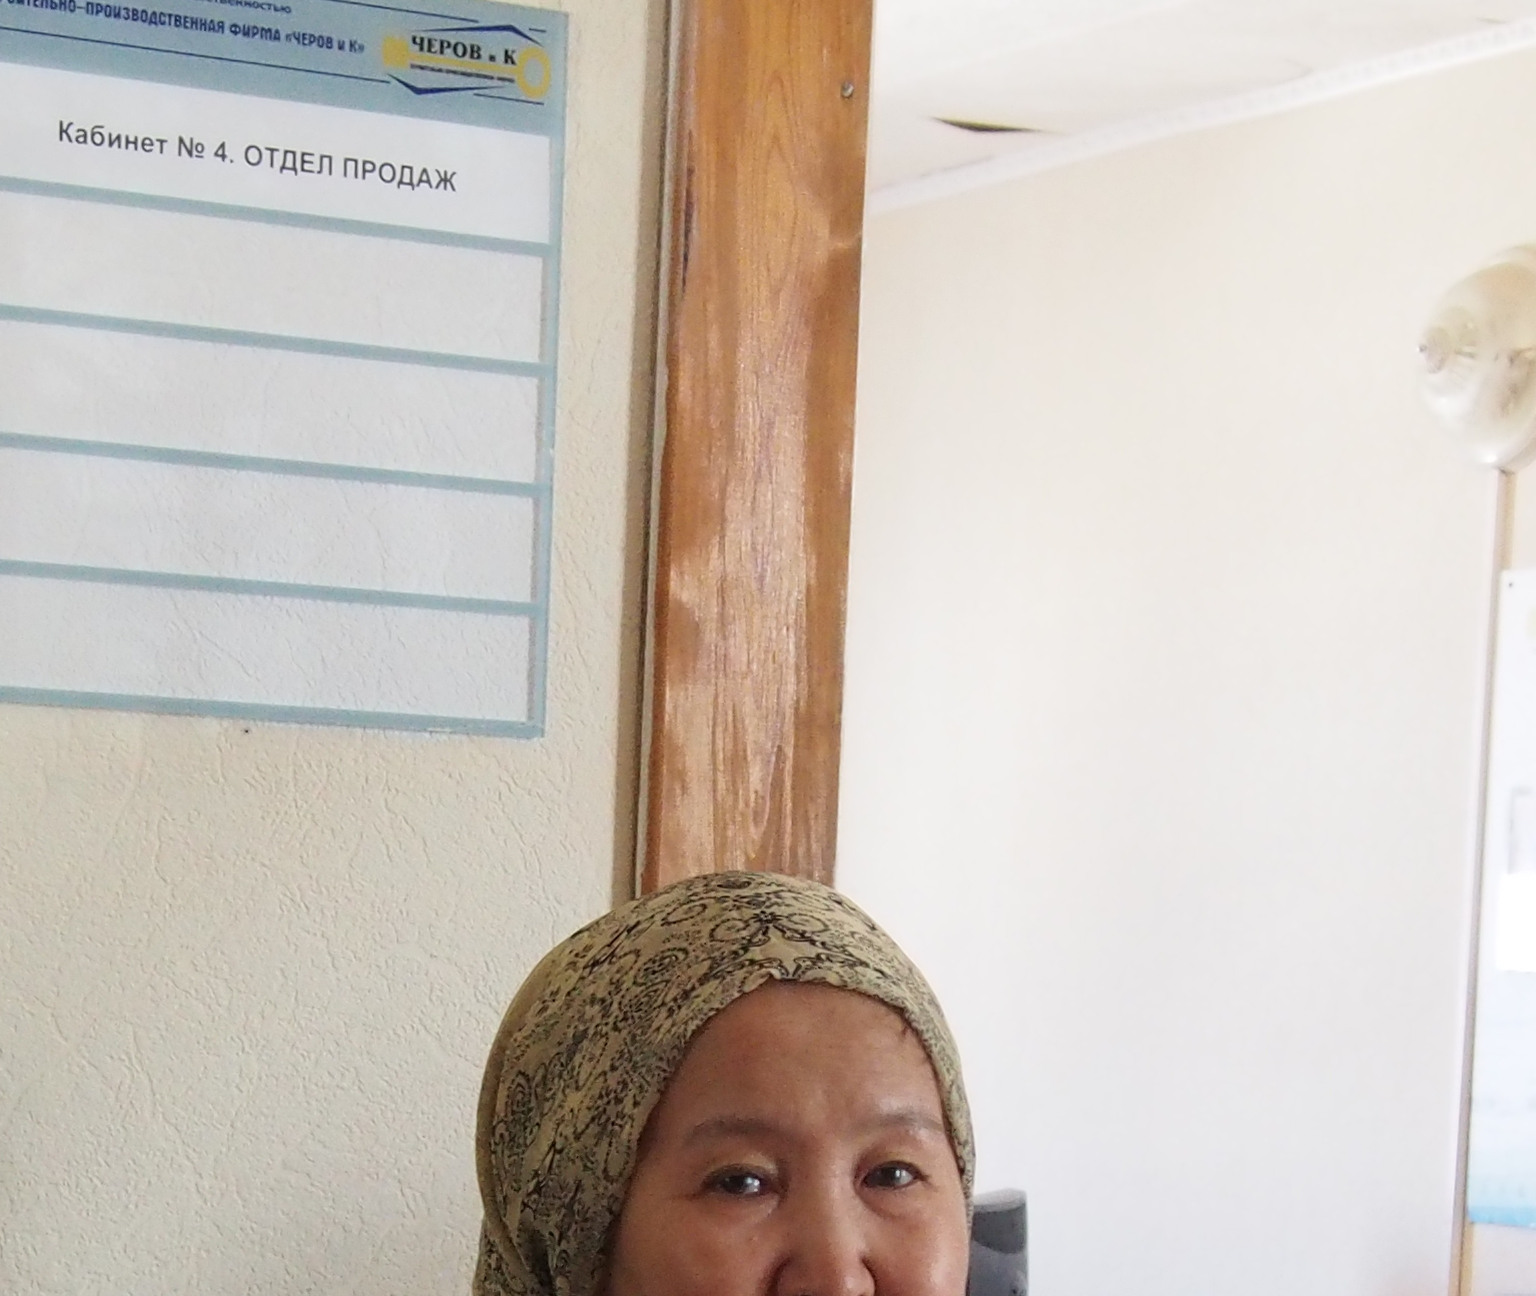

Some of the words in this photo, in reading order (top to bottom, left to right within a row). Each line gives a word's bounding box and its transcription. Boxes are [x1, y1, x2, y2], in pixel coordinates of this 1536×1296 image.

[229, 23, 281, 41] ФИРМА
[285, 30, 333, 49] «ЧЕРОВ
[411, 35, 482, 60] ЧЕРОВ
[504, 47, 517, 66] К
[58, 120, 168, 155] Кабинет
[177, 135, 205, 159] №
[213, 141, 234, 164] 4.
[244, 144, 333, 176] ОТДЕЛ
[343, 157, 457, 192] ПРОДАЖ
